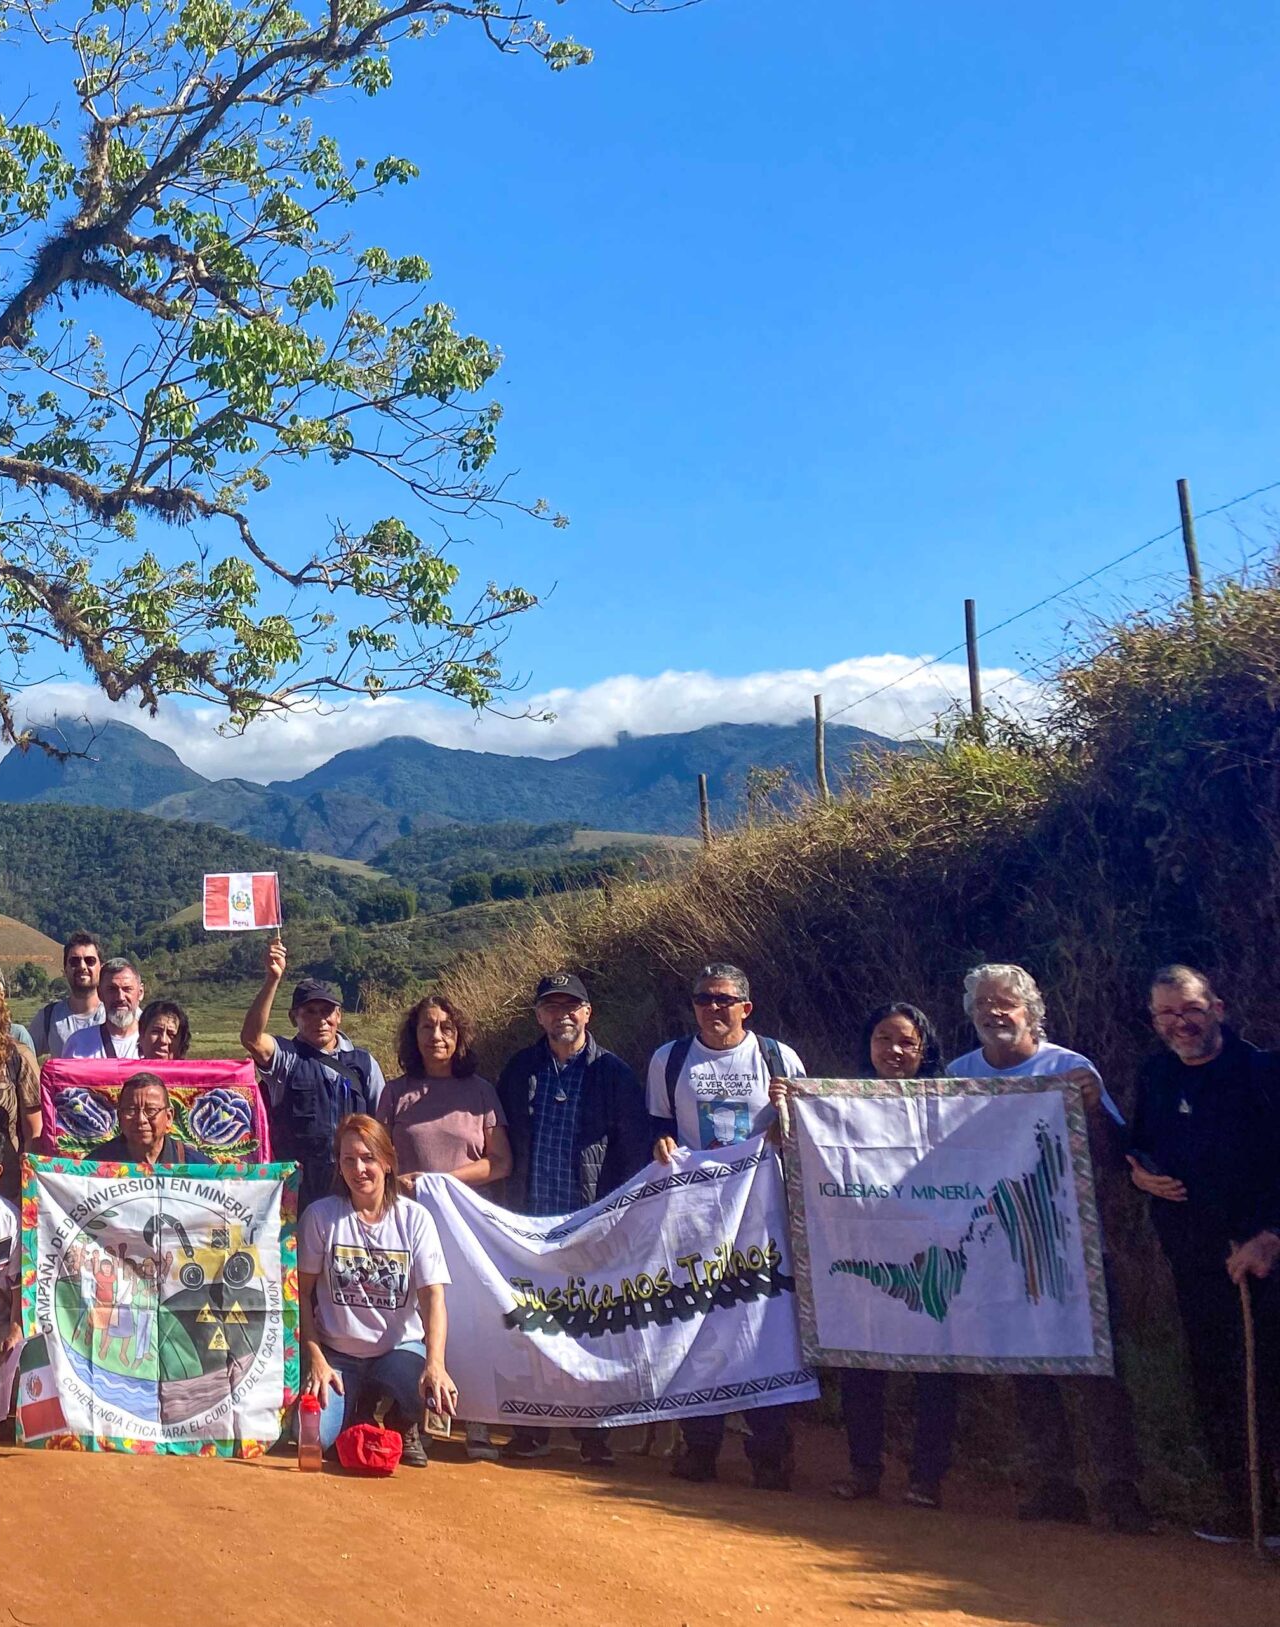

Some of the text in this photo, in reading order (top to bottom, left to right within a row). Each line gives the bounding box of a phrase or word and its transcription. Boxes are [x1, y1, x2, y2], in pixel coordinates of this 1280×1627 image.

[698, 1073, 716, 1081] QUE
[742, 1073, 758, 1081] TEM
[705, 1081, 723, 1089] VER
[818, 1182, 985, 1200] IGLESIAS Y MINERÍA
[37, 1253, 58, 1335] CAMPAÑA
[51, 1227, 69, 1249] DE
[170, 1178, 192, 1193] EN
[194, 1183, 253, 1227] MINERÍA
[510, 1238, 782, 1320] Justiça nos Trilhos
[63, 1280, 280, 1439] COHERENCIA ÉTICA PARA EL CUIDADO DE LA CASA COMÚN
